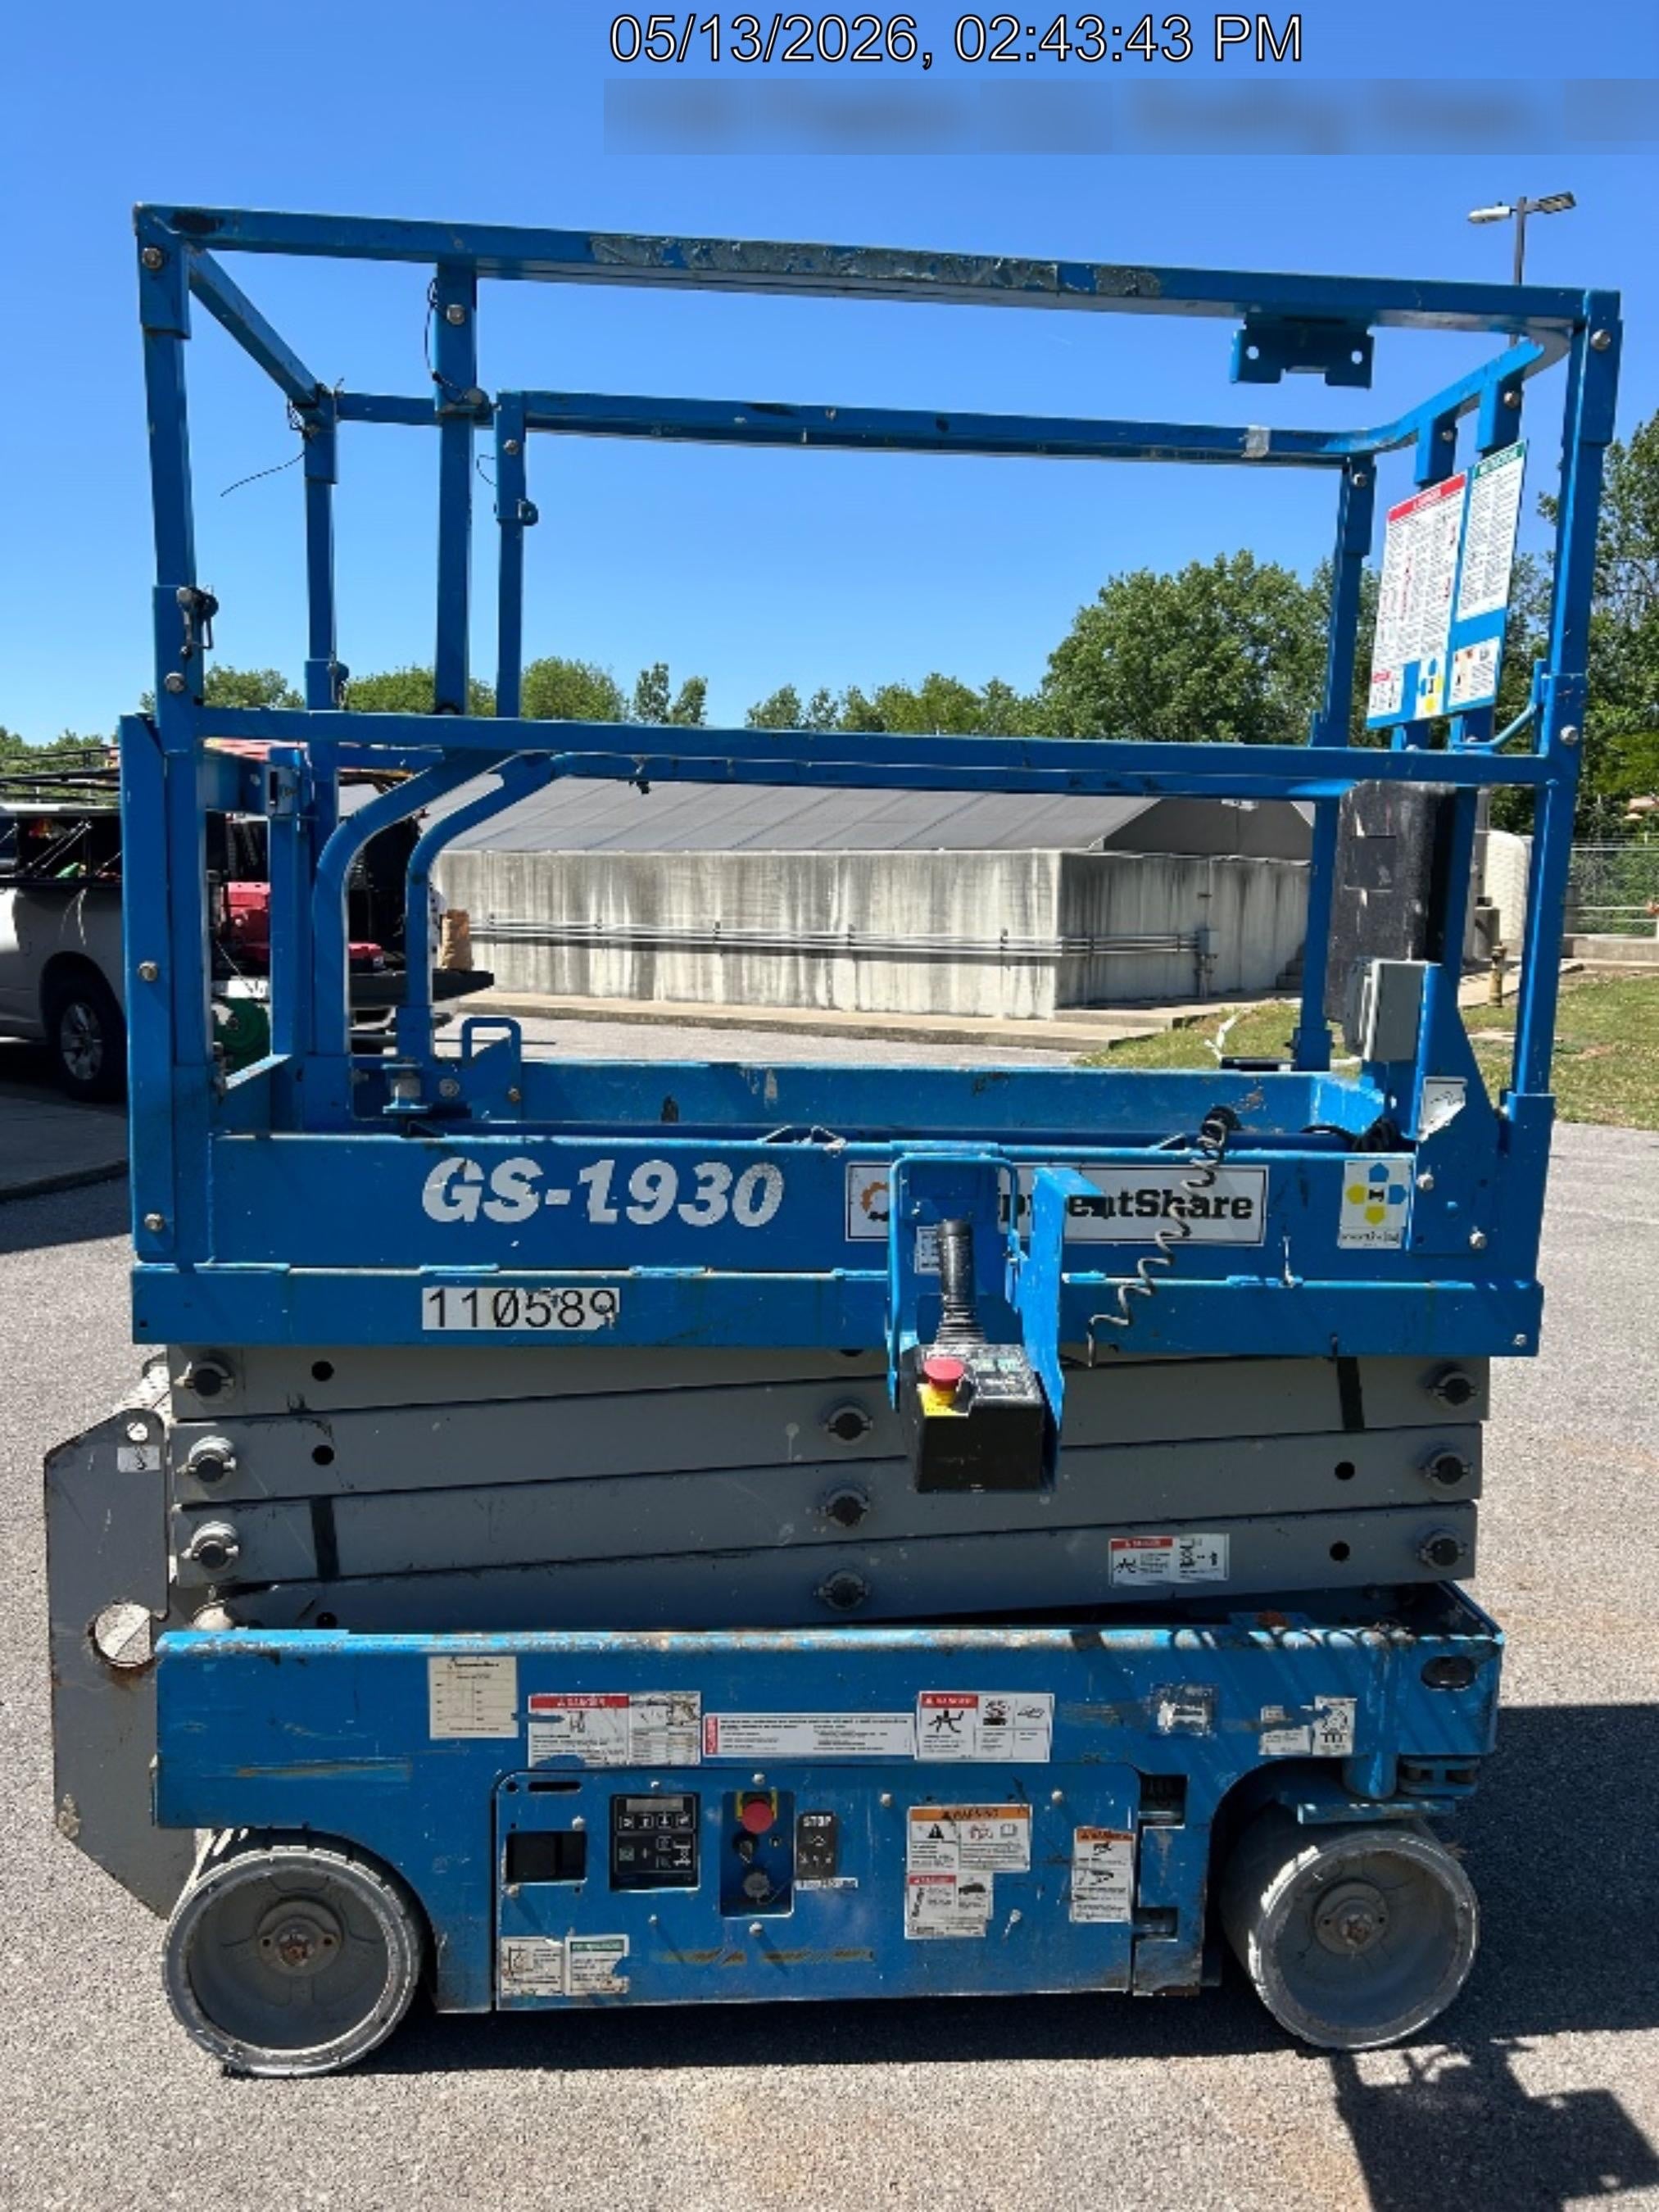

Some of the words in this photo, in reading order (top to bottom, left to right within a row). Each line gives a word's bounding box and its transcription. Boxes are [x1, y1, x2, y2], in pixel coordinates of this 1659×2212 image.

[421, 1157, 784, 1227] GS-1930
[428, 1288, 616, 1328] 110589
[803, 1815, 832, 1828] STOP
